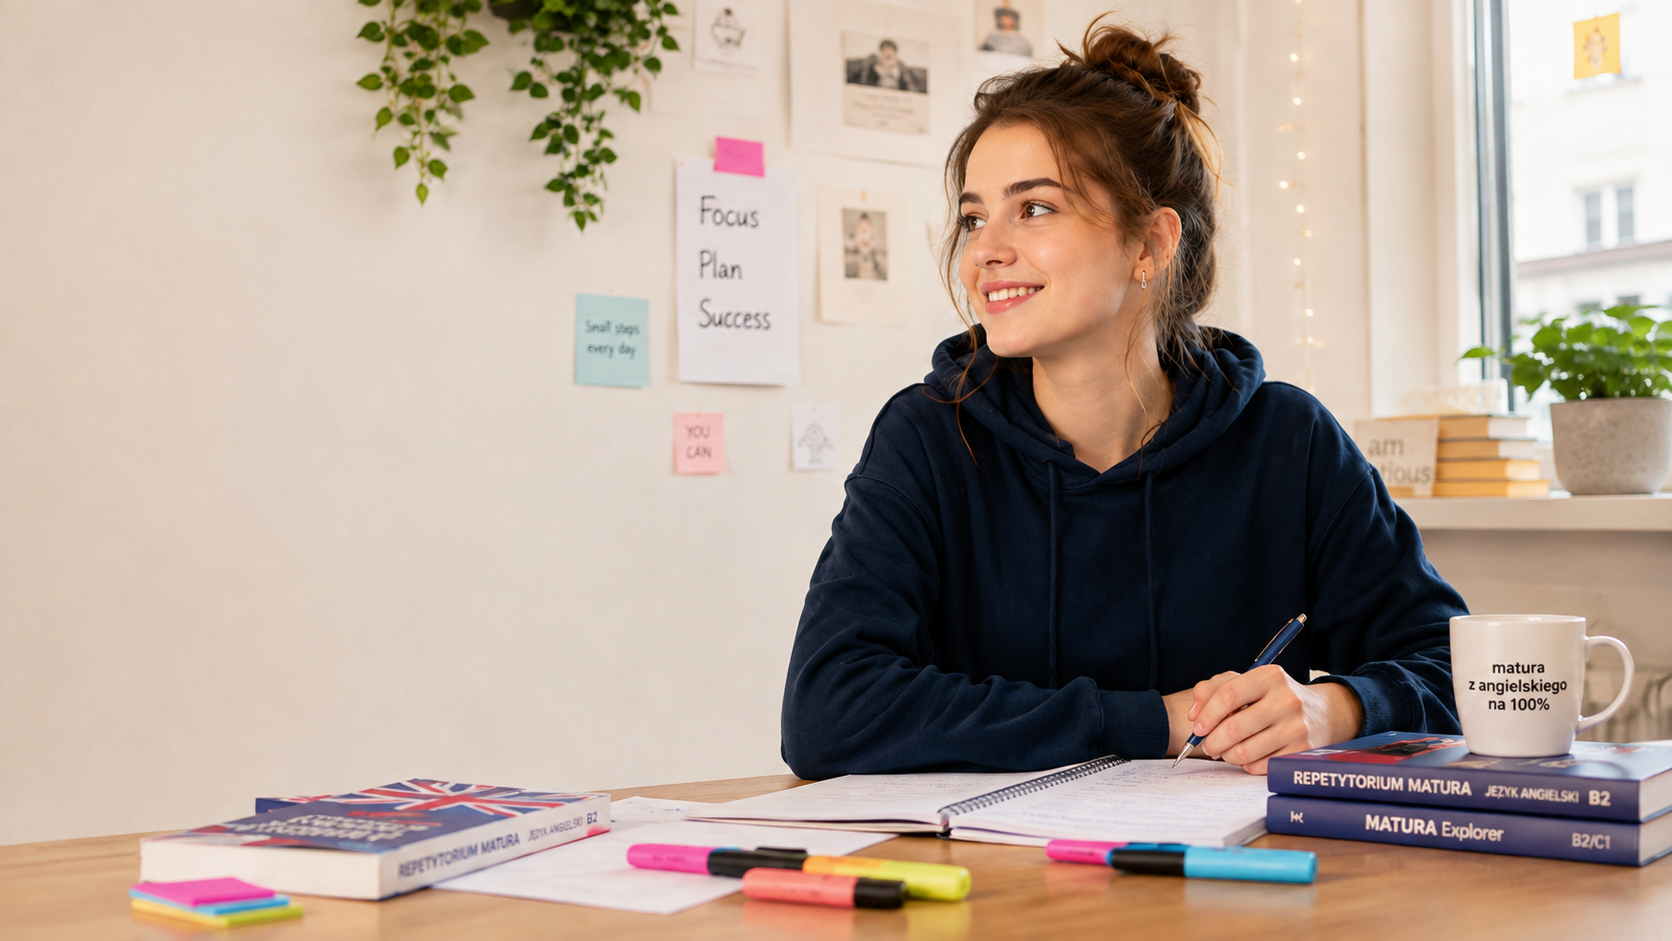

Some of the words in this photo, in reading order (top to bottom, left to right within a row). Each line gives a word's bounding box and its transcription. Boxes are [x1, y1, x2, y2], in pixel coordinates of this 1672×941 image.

[699, 195, 760, 229] Focus
[699, 249, 743, 280] Plan
[698, 298, 772, 331] Success
[614, 322, 641, 338] steps
[587, 344, 615, 359] every
[618, 341, 637, 360] day
[685, 424, 711, 439] YOU
[685, 445, 713, 460] CAN
[1367, 437, 1405, 457] am
[1492, 662, 1545, 674] matura
[1468, 680, 1476, 691] z
[1478, 679, 1568, 696] angielskiego
[1488, 699, 1506, 711] na
[1510, 698, 1550, 711] 100%
[1293, 770, 1404, 792] REPETYTORIUM
[1407, 777, 1472, 796] MATURA
[1520, 787, 1579, 803] ANGIELSKI
[1588, 789, 1611, 807] B2
[1364, 814, 1438, 836] MATURA
[1441, 821, 1504, 842] Explorer
[1571, 832, 1611, 850] B2/C1
[398, 842, 479, 880] REPETYTORIUM
[480, 832, 520, 855] MATURA
[586, 811, 598, 825] B2
